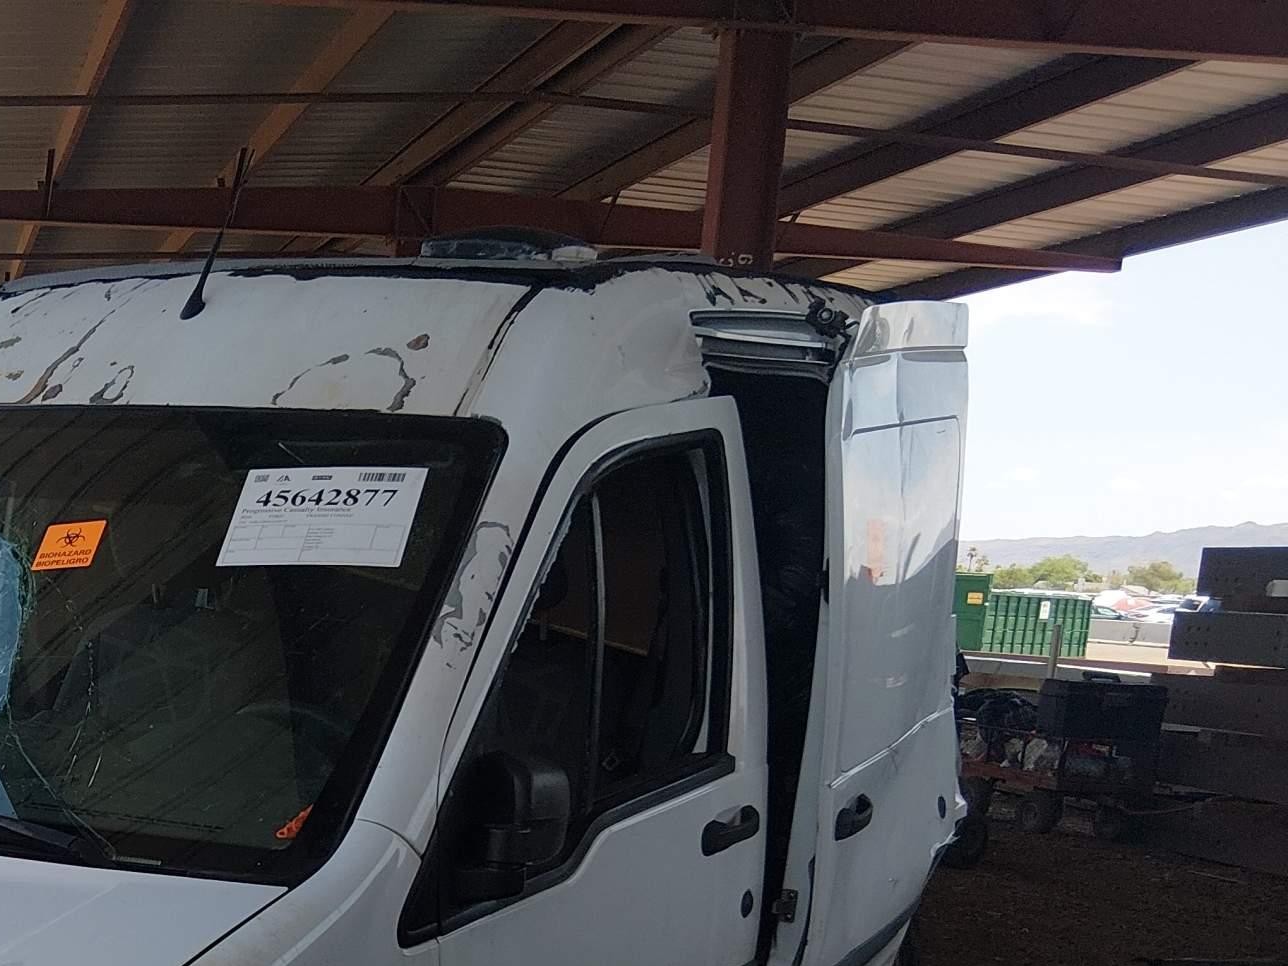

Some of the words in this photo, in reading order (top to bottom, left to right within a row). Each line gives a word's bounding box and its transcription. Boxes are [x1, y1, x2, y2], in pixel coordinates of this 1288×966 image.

[256, 488, 399, 507] 45642877
[38, 549, 92, 559] BIOHAZARD
[35, 557, 89, 567] BIOPELIGRO
